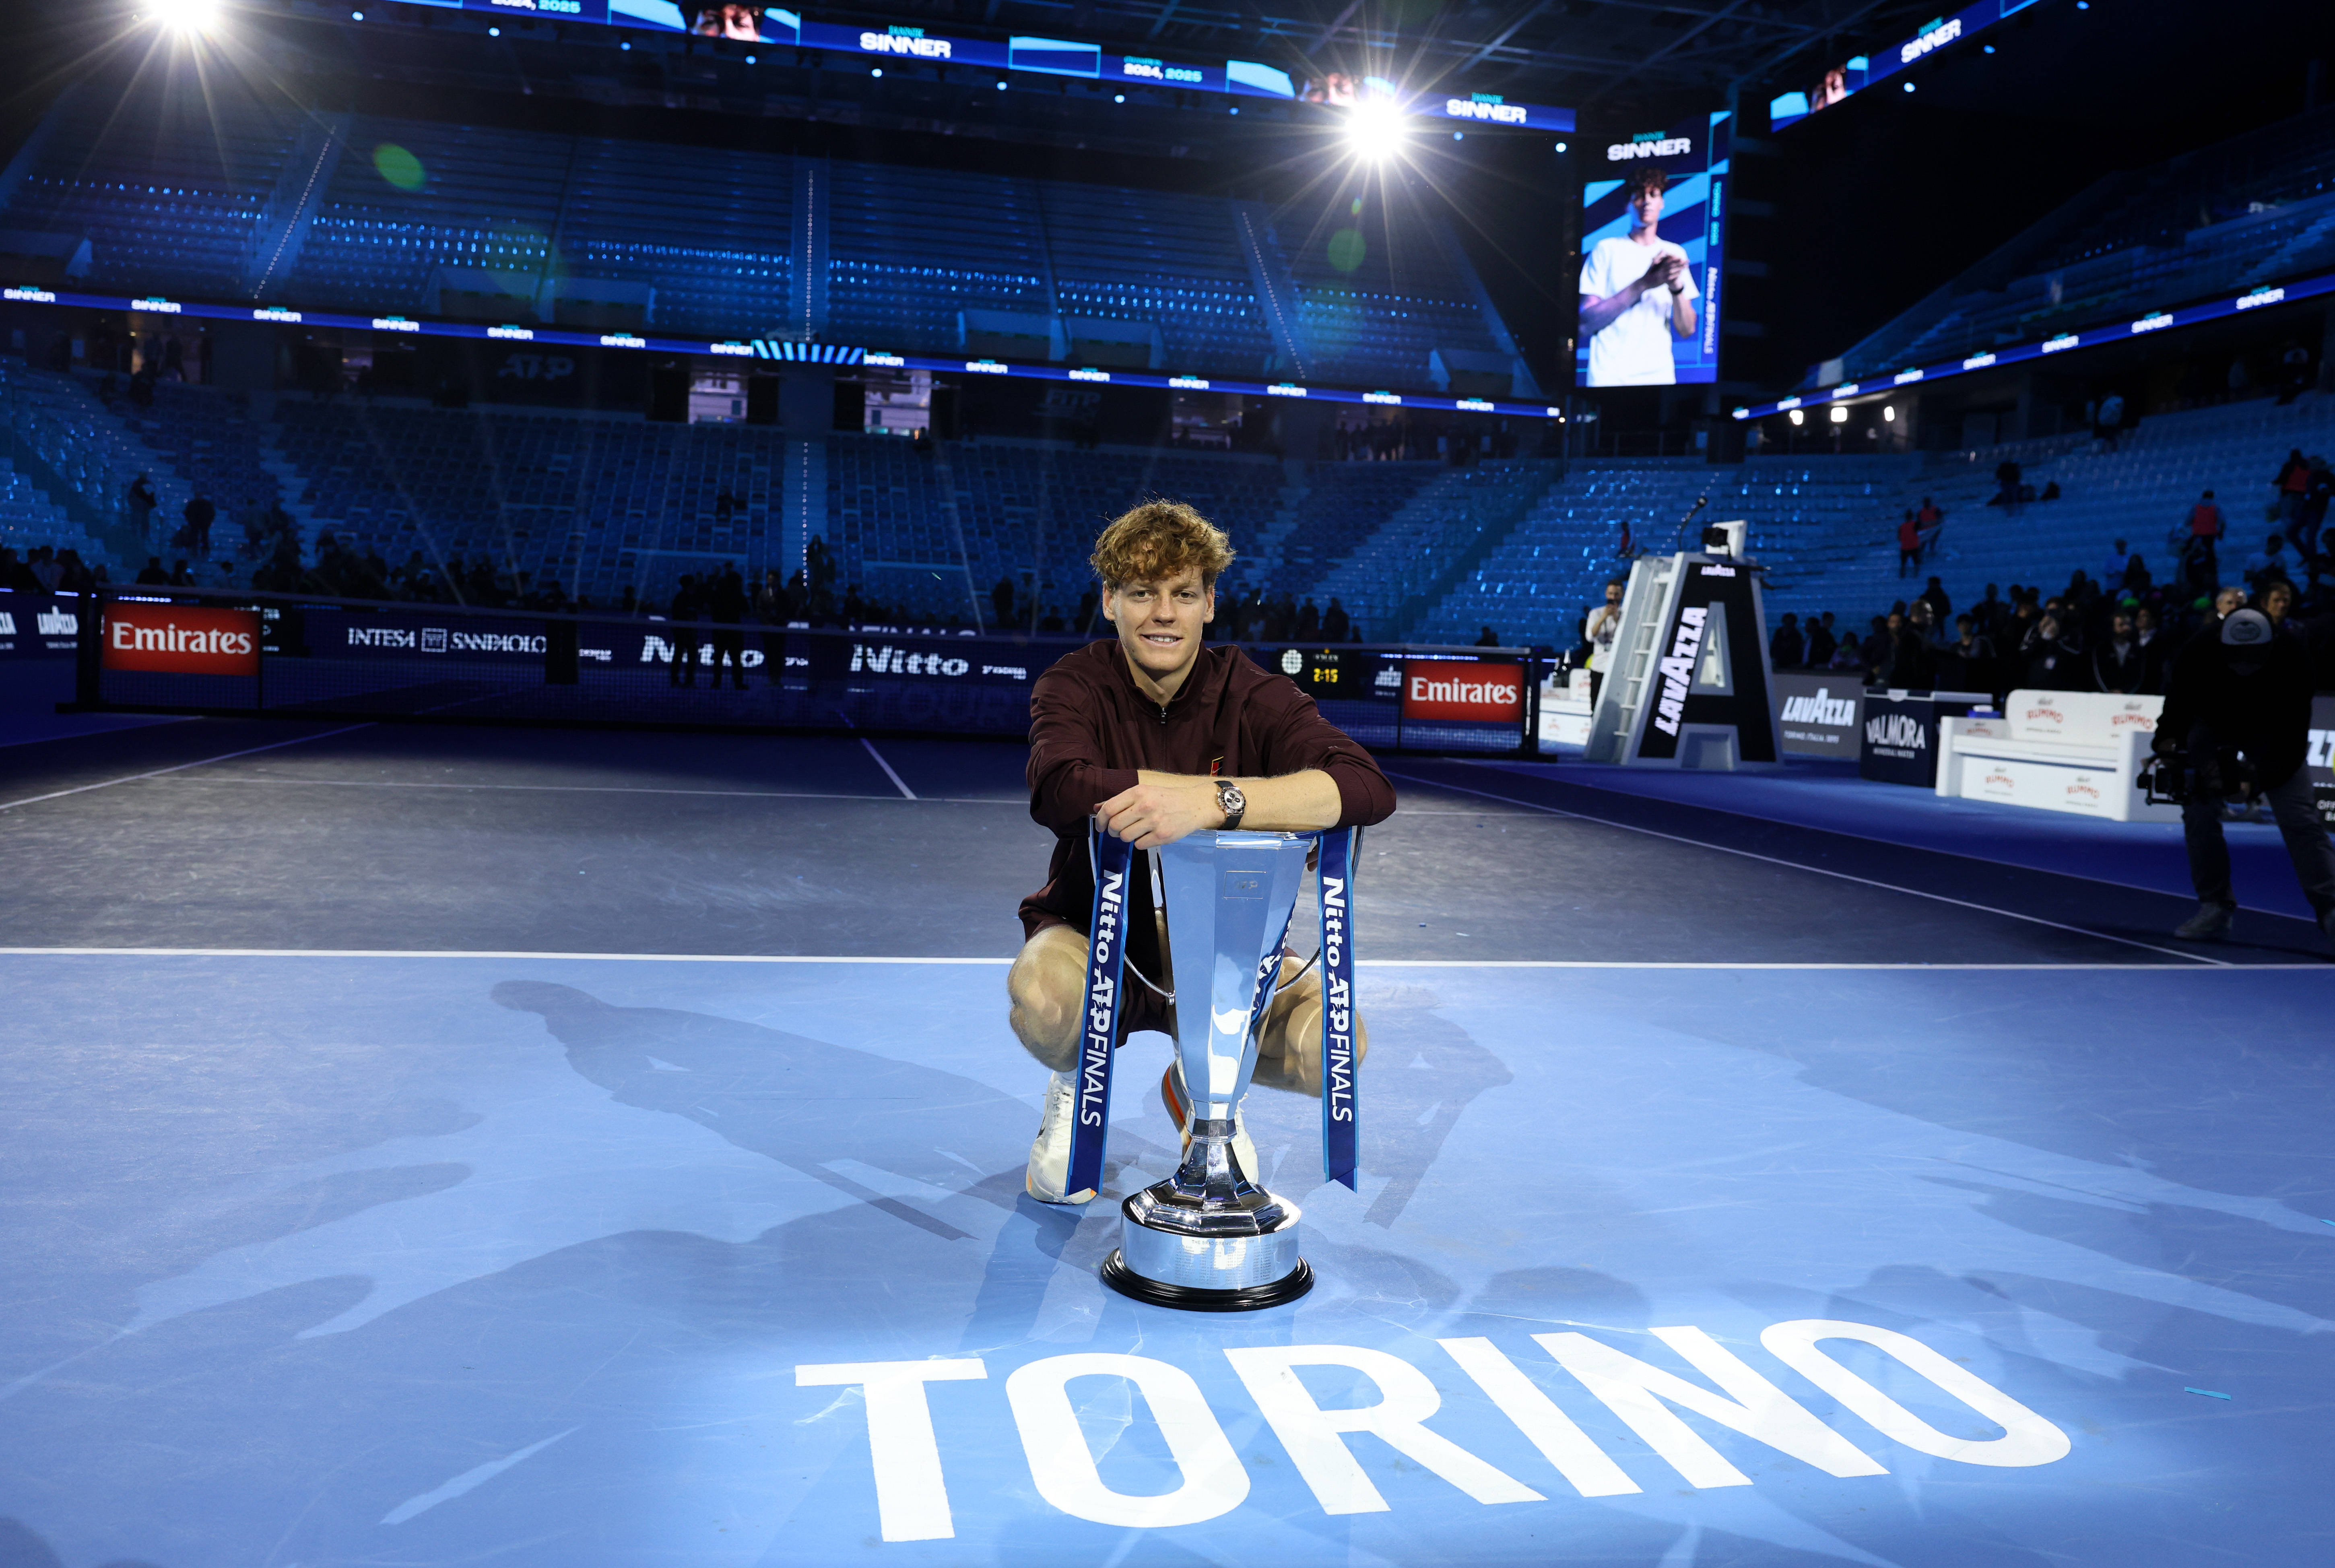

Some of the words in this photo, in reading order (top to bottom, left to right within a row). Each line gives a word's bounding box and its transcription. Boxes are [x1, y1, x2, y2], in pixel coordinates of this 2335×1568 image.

[538, 0, 581, 13] 2025
[860, 32, 951, 58] SINNER
[1901, 19, 1961, 63] SINNER
[1446, 99, 1526, 124] SINNER
[1607, 138, 1691, 161] SINNER
[4, 289, 56, 302] SINNER
[131, 299, 182, 313] SINNER
[2236, 289, 2284, 309] SINNER
[253, 309, 302, 322] SINNER
[372, 318, 419, 332] SINNER
[2131, 314, 2173, 333] SINNER
[487, 327, 533, 340] SINNER
[112, 622, 252, 654] Emirates
[850, 644, 969, 676] Nitto
[1655, 607, 1708, 736] LAVAZZA
[1314, 668, 1338, 683] 2:15
[1411, 677, 1517, 704] Emirates
[1780, 687, 1856, 727] LAVAZZA
[1865, 714, 1926, 749] VALMORA
[1097, 869, 1122, 963] Nitto
[1323, 877, 1345, 967] Nitto
[1091, 965, 1114, 1032] ATP
[1328, 968, 1349, 1032] ATP
[1081, 1033, 1108, 1127] FINALS
[1330, 1033, 1352, 1122] FINALS
[795, 1319, 2071, 1542] TORINO
